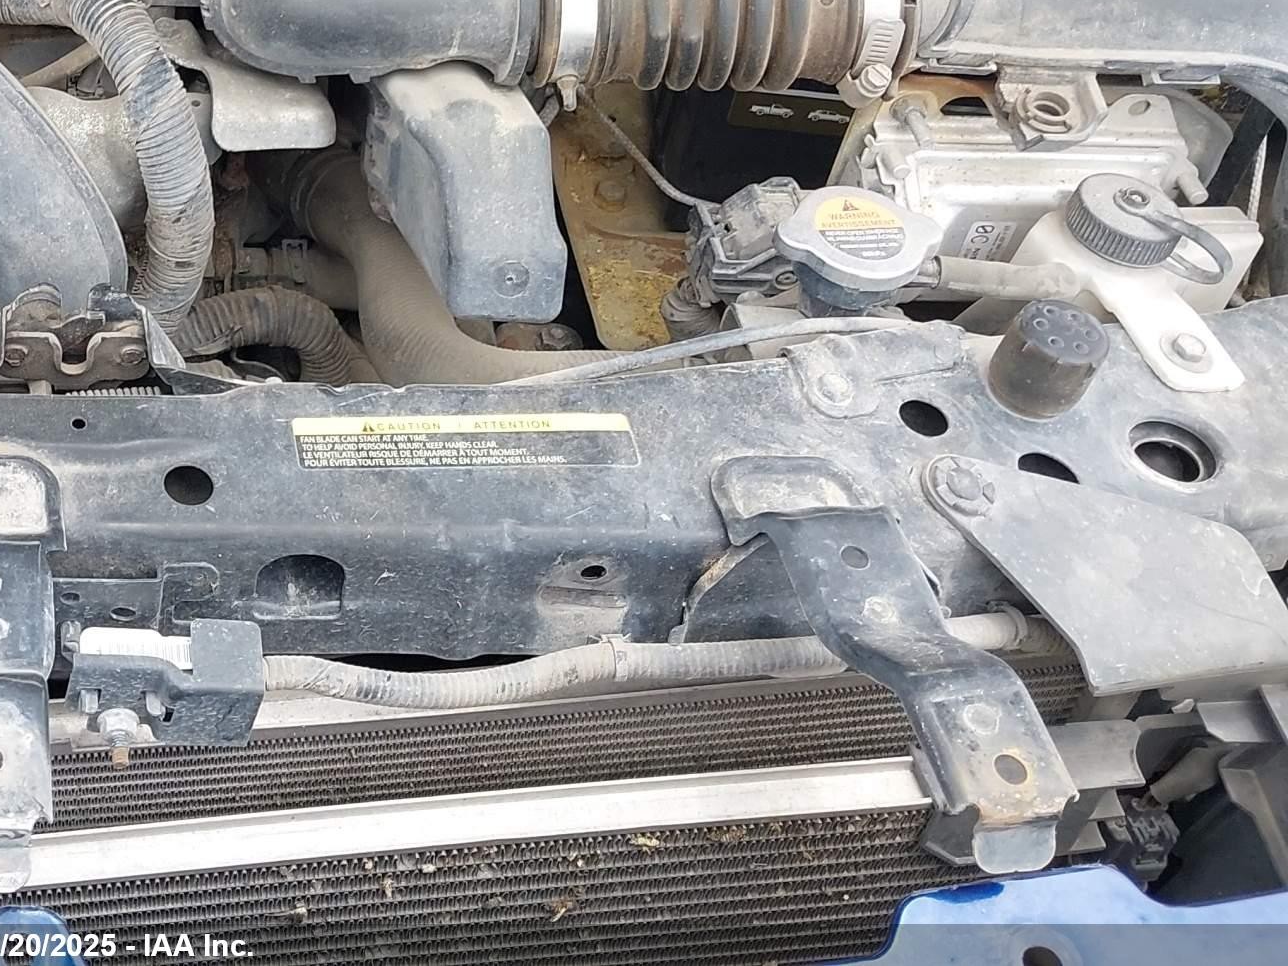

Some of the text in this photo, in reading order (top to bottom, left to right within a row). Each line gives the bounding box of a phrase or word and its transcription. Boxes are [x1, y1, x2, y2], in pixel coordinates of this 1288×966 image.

[827, 211, 880, 221] WARNING
[376, 420, 551, 431] CAUTION ATTENTION
[299, 435, 315, 443] FAN
[316, 435, 340, 443] BLADE
[341, 435, 358, 443] CAN
[359, 435, 381, 443] START
[392, 434, 408, 442] ANY
[358, 442, 397, 450] PERSONAL
[303, 451, 313, 459] LE
[369, 450, 399, 458] RISQUE
[400, 450, 411, 458] DE
[467, 448, 488, 456] TOUT
[304, 459, 327, 467] POUR
[358, 458, 385, 466] TOUTE
[429, 457, 441, 465] NE
[442, 457, 457, 465] PAS
[458, 456, 470, 464] EN
[471, 456, 521, 464] APPROCHER
[522, 456, 537, 464] LES
